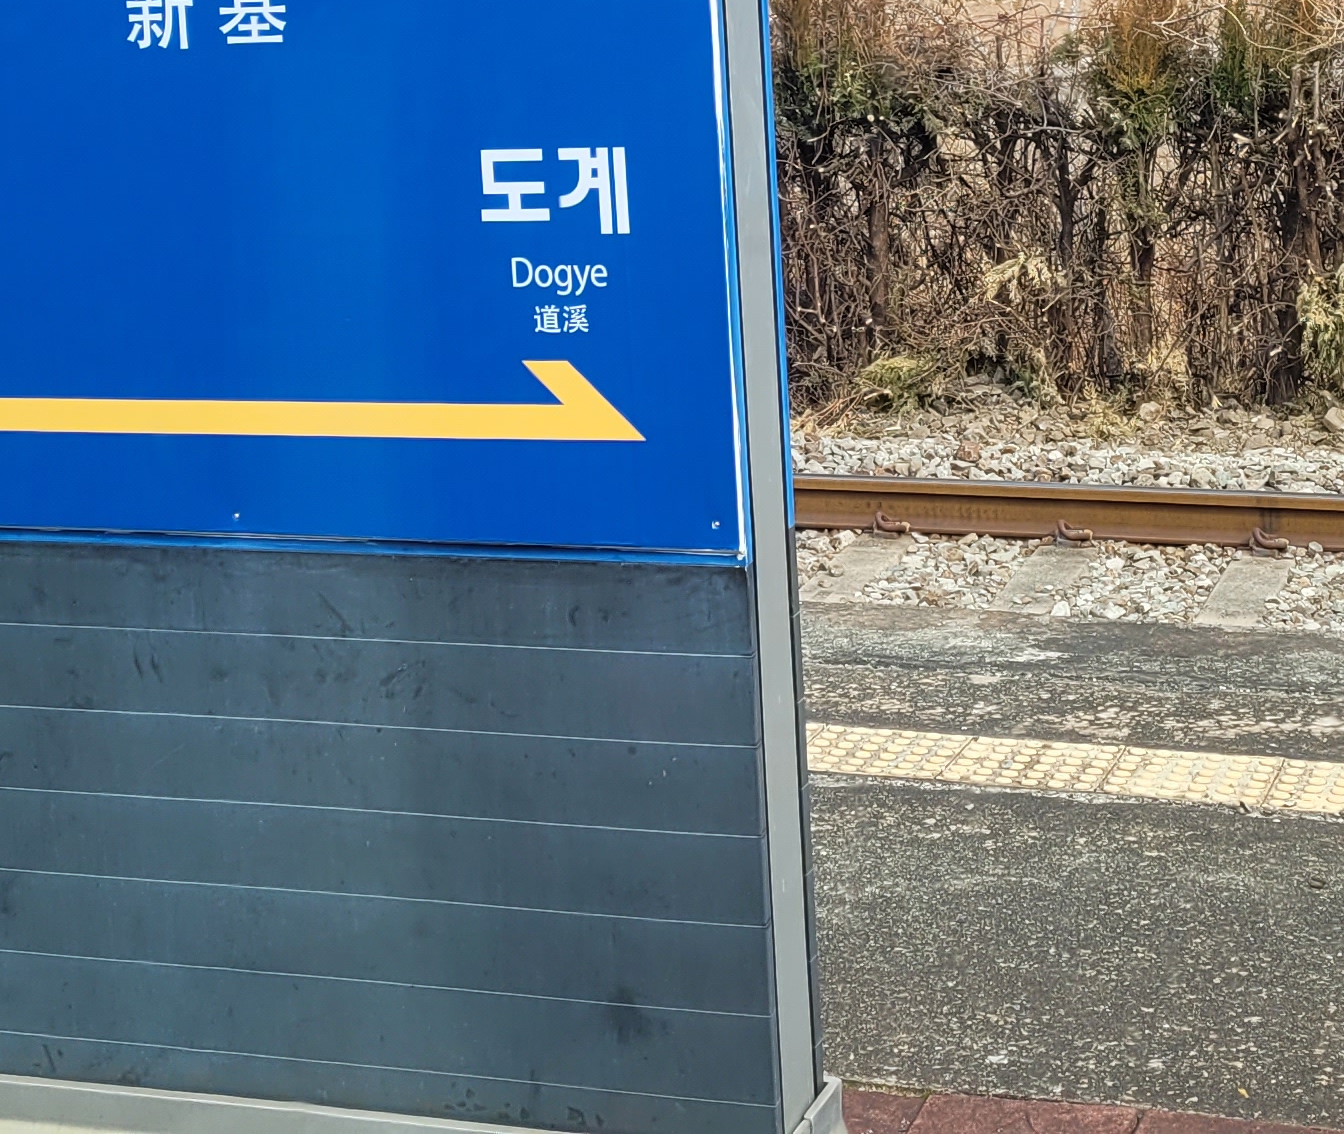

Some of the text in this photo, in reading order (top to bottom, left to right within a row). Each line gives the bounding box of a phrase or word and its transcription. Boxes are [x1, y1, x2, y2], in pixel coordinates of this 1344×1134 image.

[480, 146, 631, 235] 도계
[511, 257, 608, 296] Dogye
[533, 304, 590, 334] 道溪
